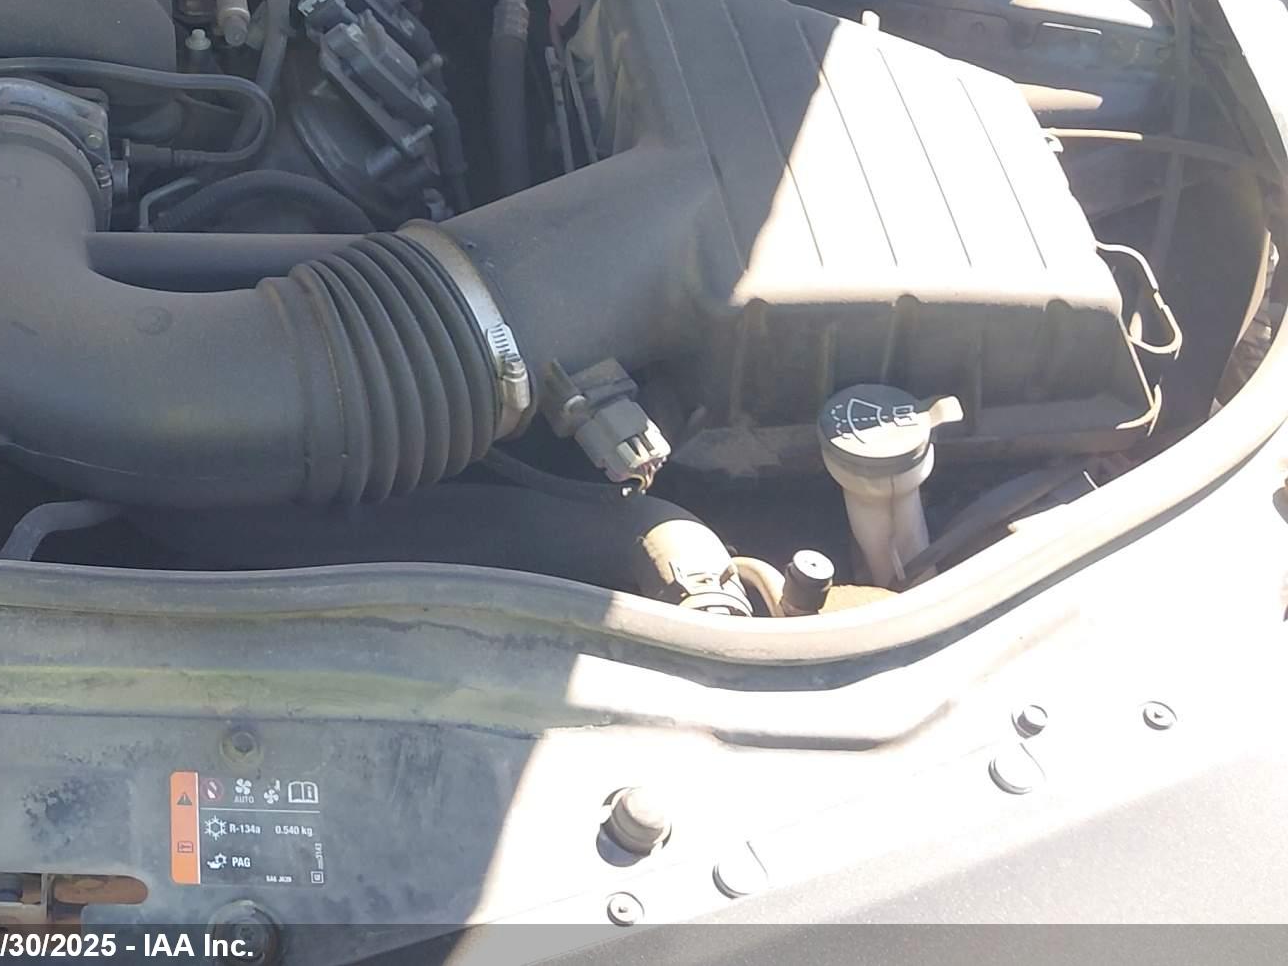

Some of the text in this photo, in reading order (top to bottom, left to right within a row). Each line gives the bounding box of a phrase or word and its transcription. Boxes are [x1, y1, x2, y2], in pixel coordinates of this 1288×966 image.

[234, 795, 255, 804] AUTO
[229, 824, 313, 837] R-134a 0.540 kg
[231, 857, 251, 867] PAG
